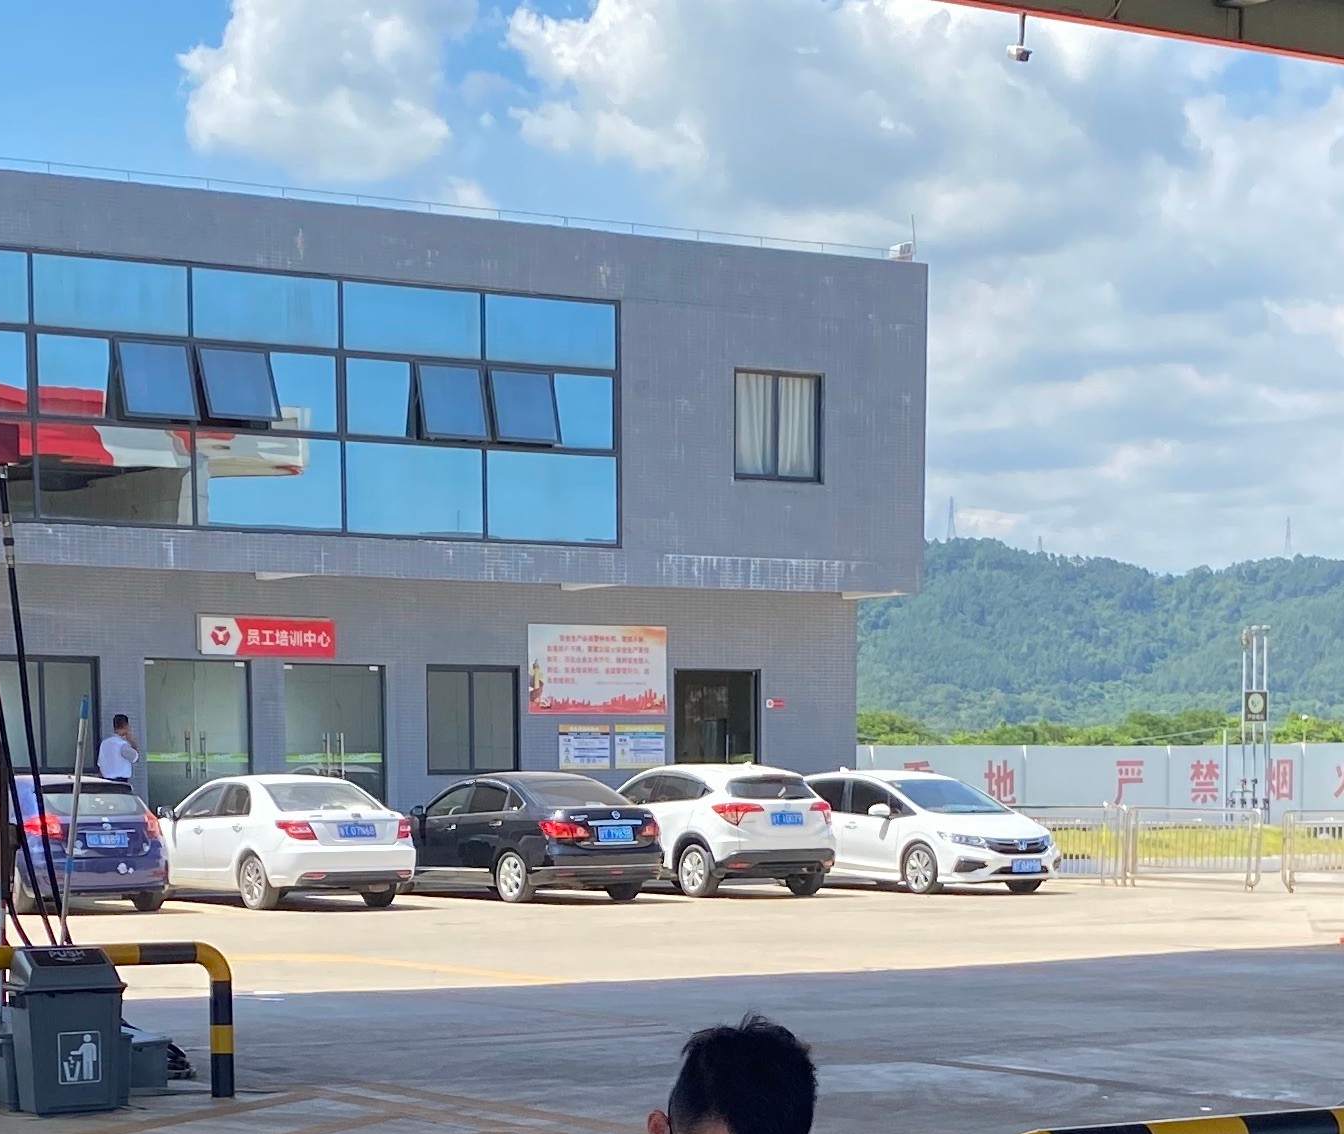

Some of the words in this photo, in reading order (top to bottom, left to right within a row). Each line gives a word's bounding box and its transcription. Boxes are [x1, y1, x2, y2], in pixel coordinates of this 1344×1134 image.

[246, 628, 332, 648] 员工培训中心
